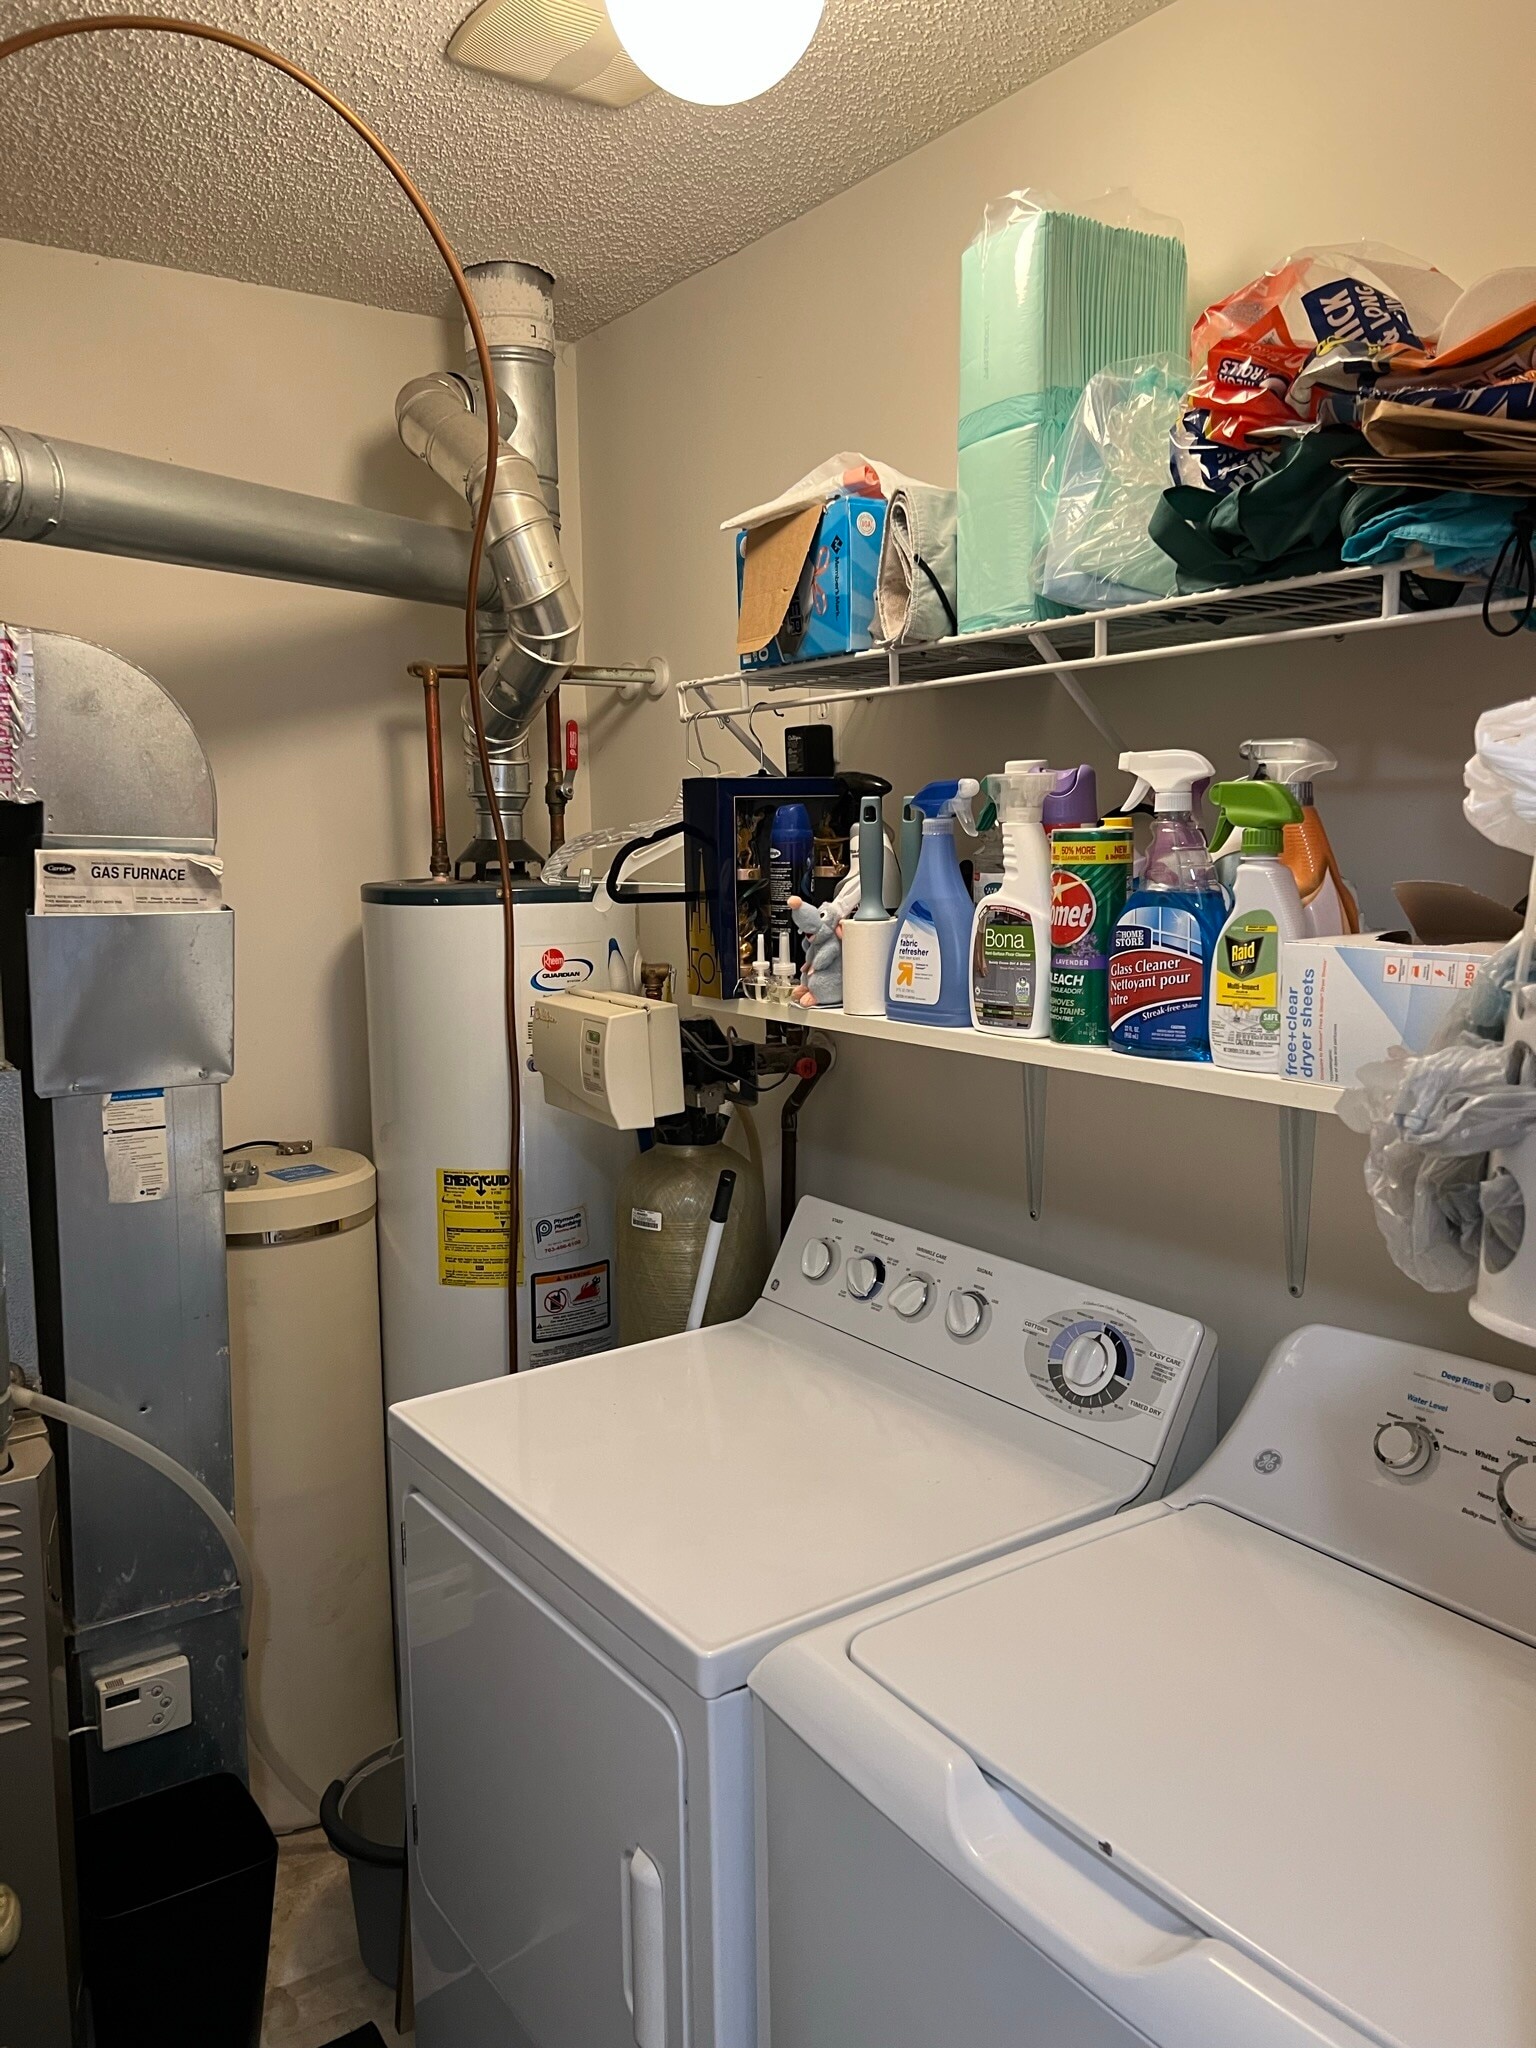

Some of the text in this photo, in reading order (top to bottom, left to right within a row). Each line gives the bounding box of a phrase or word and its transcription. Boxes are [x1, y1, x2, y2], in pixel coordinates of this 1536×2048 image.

[1354, 285, 1392, 331] LONG
[1220, 359, 1264, 382] ROLLS
[1061, 846, 1097, 855] 50% MORE
[1114, 845, 1128, 854] NEW
[47, 864, 72, 874] Carrier
[91, 866, 186, 881] GAS FURNACE
[1050, 903, 1092, 928] omet
[985, 928, 1026, 949] Bona
[1121, 930, 1145, 939] HOME
[900, 939, 918, 948] fabric
[1115, 937, 1145, 947] STORE
[543, 949, 564, 968] Rheem
[898, 947, 930, 957] refresher
[1231, 942, 1256, 961] Raid
[1110, 958, 1181, 976] Glass Cleaner
[542, 971, 581, 979] GUARDIAN
[1050, 972, 1085, 987] LEACH
[1110, 972, 1191, 992] Nettoyant pour
[1464, 964, 1476, 987] 250
[1226, 982, 1260, 991] Multi-Insect
[1110, 994, 1128, 1006] vitre
[1059, 1007, 1086, 1016] STAINS
[1142, 1002, 1198, 1021] Streak-free Shine
[1263, 1013, 1279, 1021] SAFE
[1300, 968, 1315, 1078] dryer sheets
[1286, 986, 1299, 1076] free+clear
[443, 1174, 511, 1188] ENERGYGUID
[553, 1212, 582, 1225] Plymouth
[554, 1218, 582, 1231] Plumbing
[935, 1252, 948, 1261] CARE
[1024, 1320, 1049, 1334] COTTONS
[1149, 1350, 1182, 1367] EASY CARE
[1441, 1370, 1461, 1383] Deep
[1461, 1376, 1484, 1390] Rinse
[1129, 1399, 1162, 1417] TIMED DRY
[1407, 1393, 1449, 1412] Water Level
[1415, 1415, 1427, 1423] High
[1474, 1448, 1499, 1463] Whites
[1476, 1490, 1496, 1503] Heavy
[1461, 1506, 1480, 1519] Bulky
